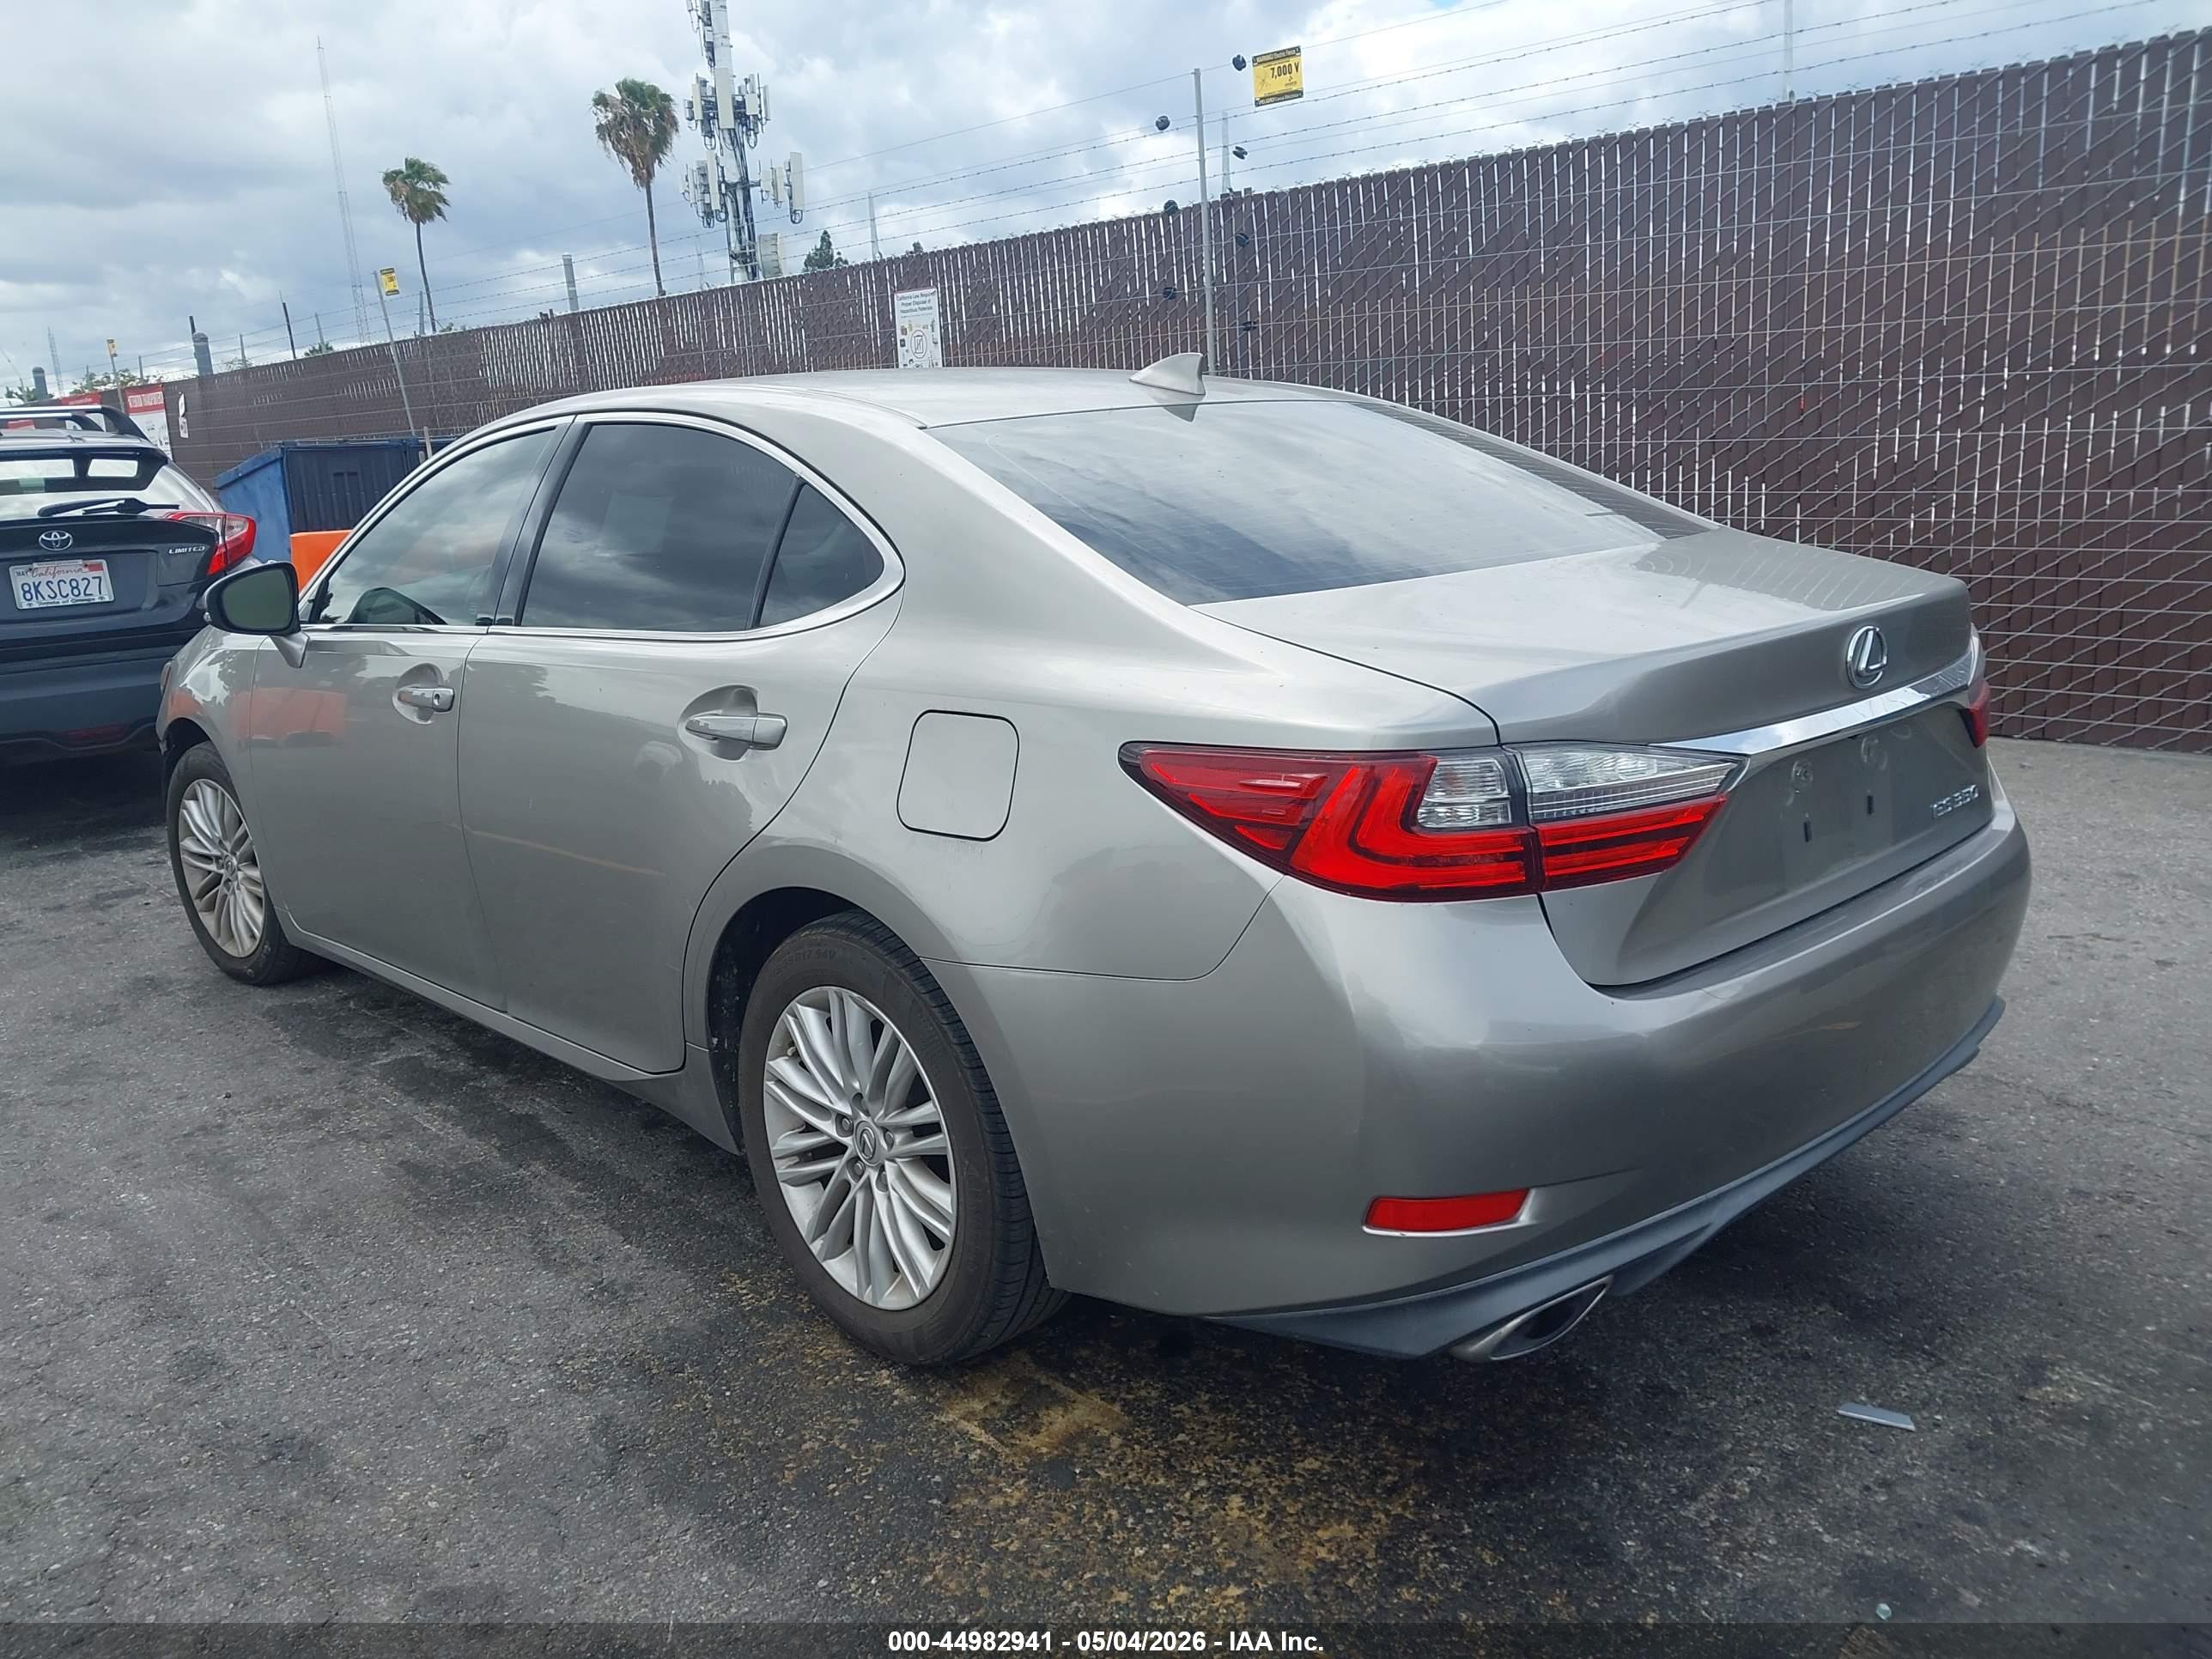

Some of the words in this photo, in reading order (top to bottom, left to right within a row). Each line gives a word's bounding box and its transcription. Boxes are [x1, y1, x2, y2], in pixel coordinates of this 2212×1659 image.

[1270, 64, 1292, 80] 7,000
[1294, 62, 1299, 74] V
[168, 545, 206, 555] LIMITED
[31, 566, 83, 579] California
[21, 575, 102, 602] 8KSC827
